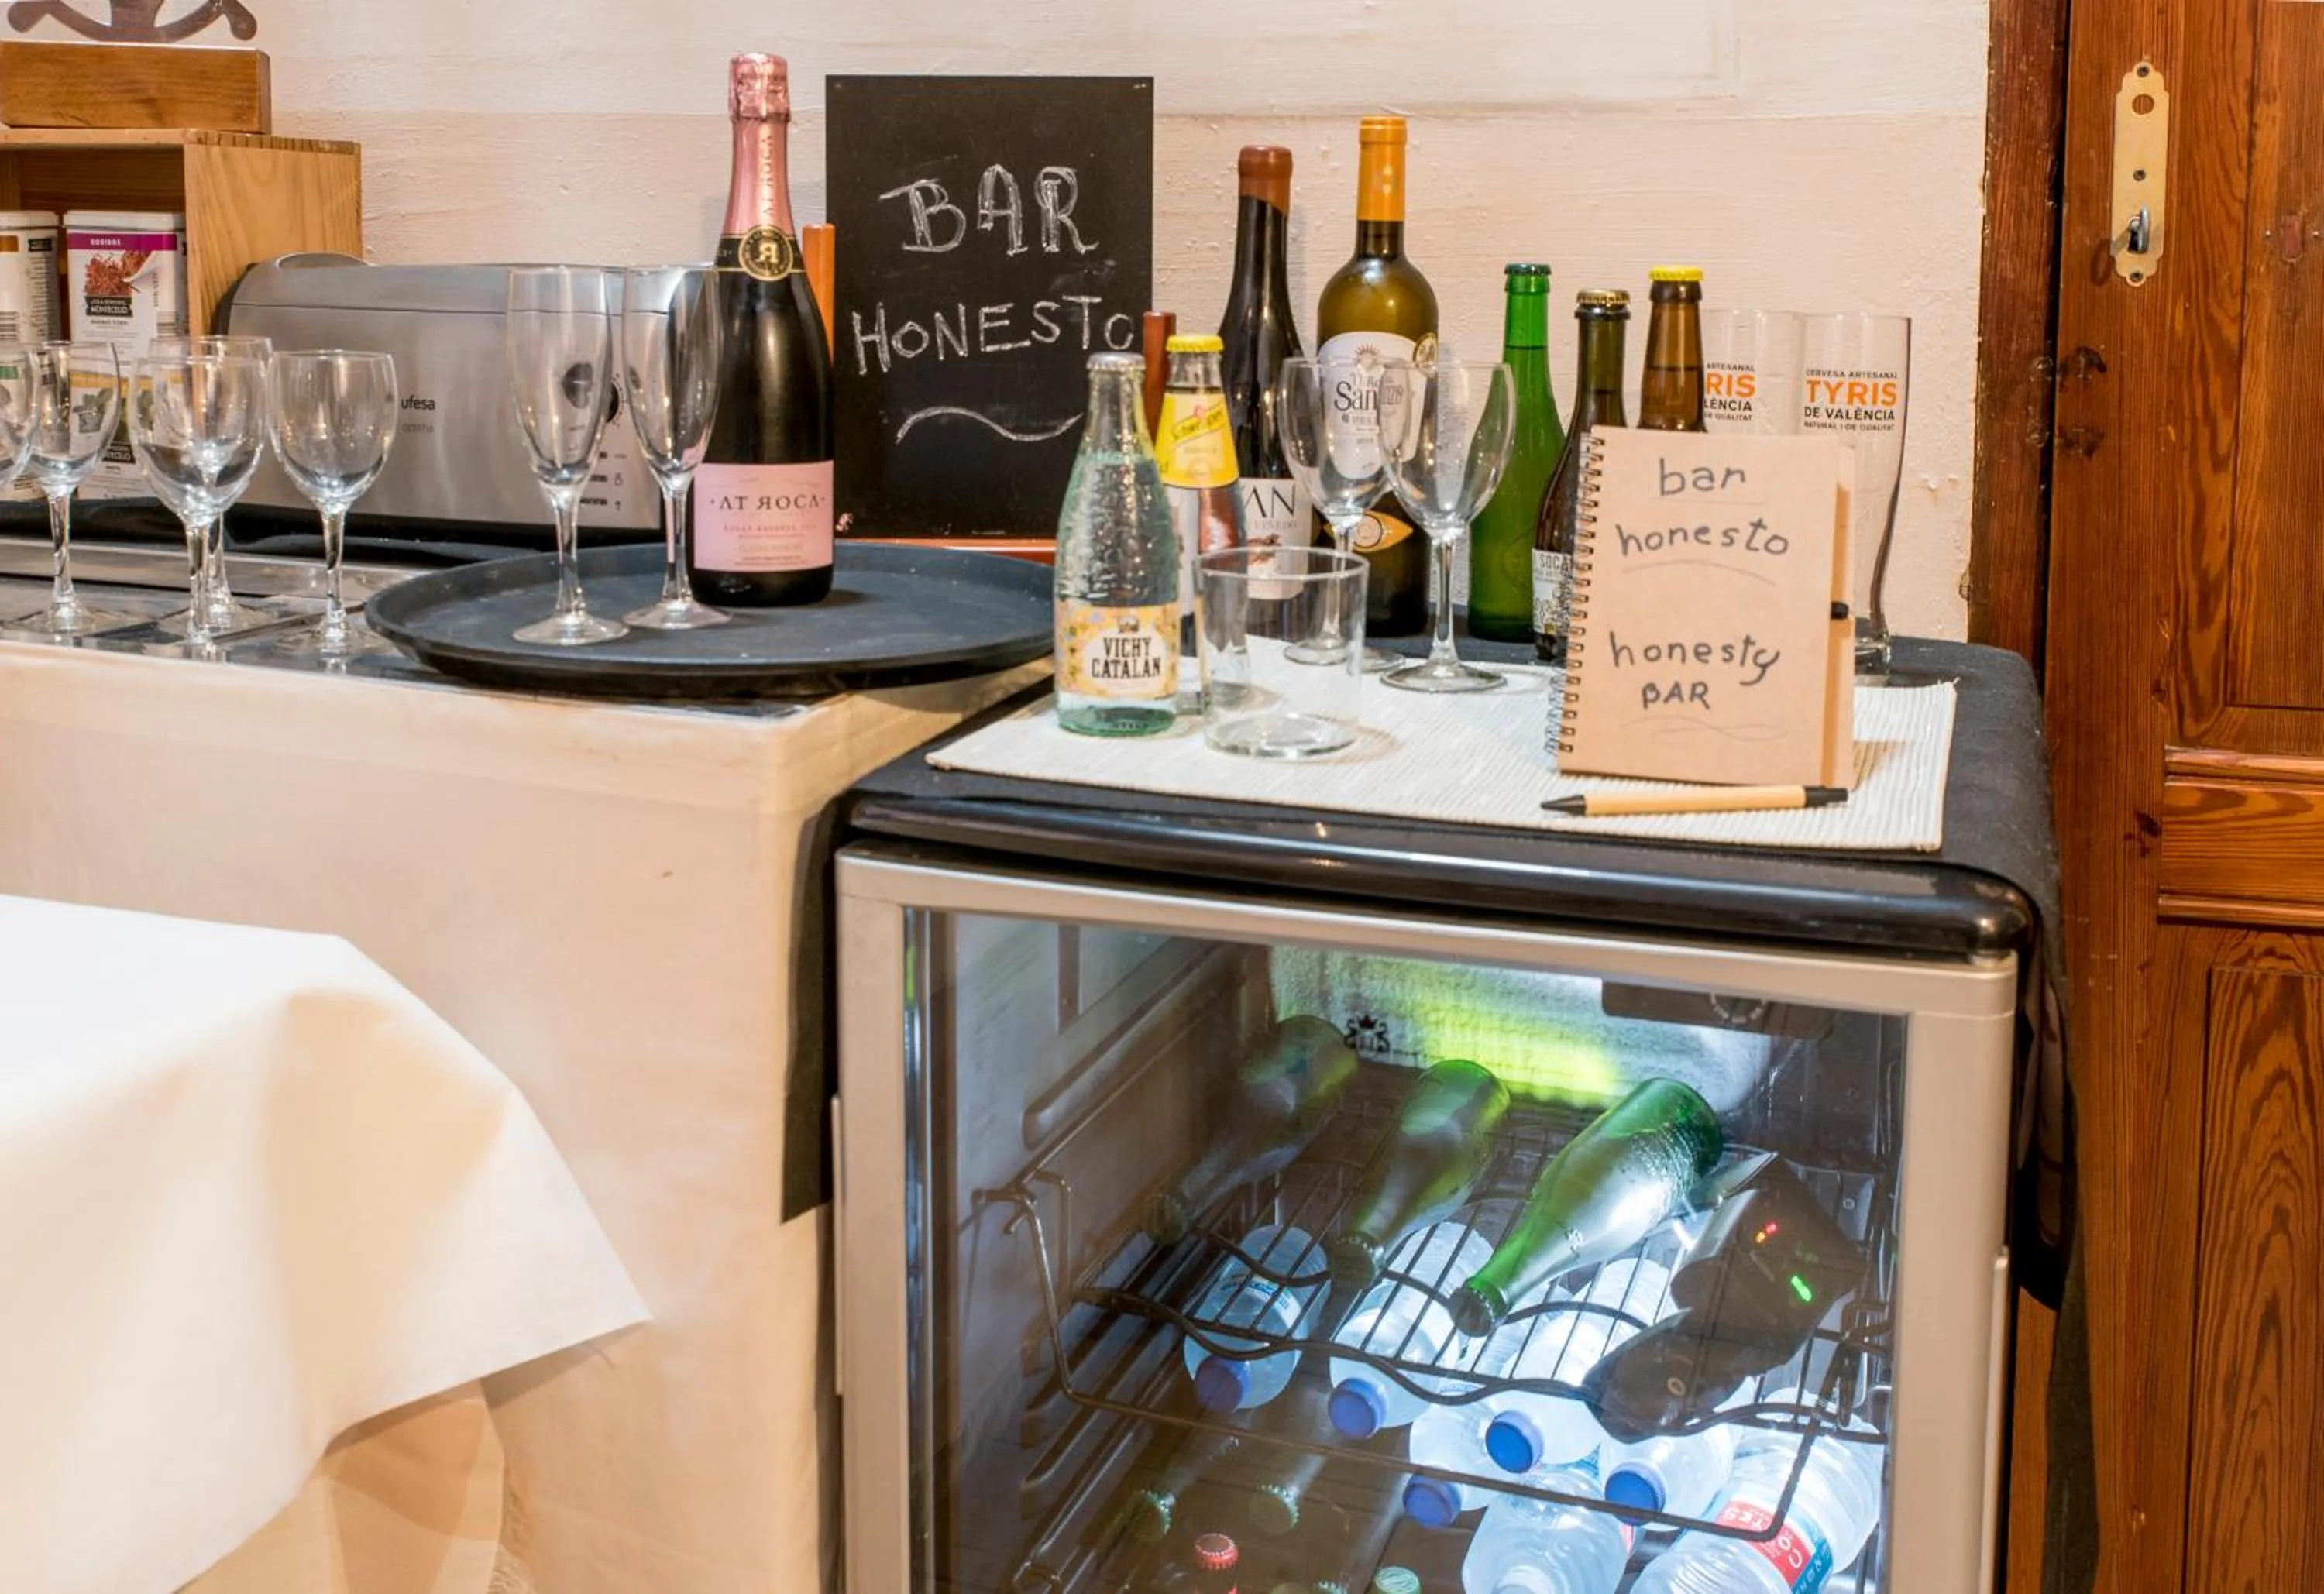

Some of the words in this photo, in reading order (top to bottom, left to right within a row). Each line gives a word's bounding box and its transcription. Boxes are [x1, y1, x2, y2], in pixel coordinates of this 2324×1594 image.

[878, 163, 1100, 256] BAR
[1707, 373, 1756, 397] RIS
[1807, 379, 1898, 407] TYRIS
[401, 393, 435, 411] ufesa
[1804, 406, 1820, 418] DE
[719, 496, 748, 510] AT
[1615, 517, 1789, 558] honesto
[1103, 637, 1152, 658] VICHY
[1610, 631, 1780, 686] honesty
[1092, 658, 1161, 679] CATALAN
[1641, 681, 1710, 710] BAR
